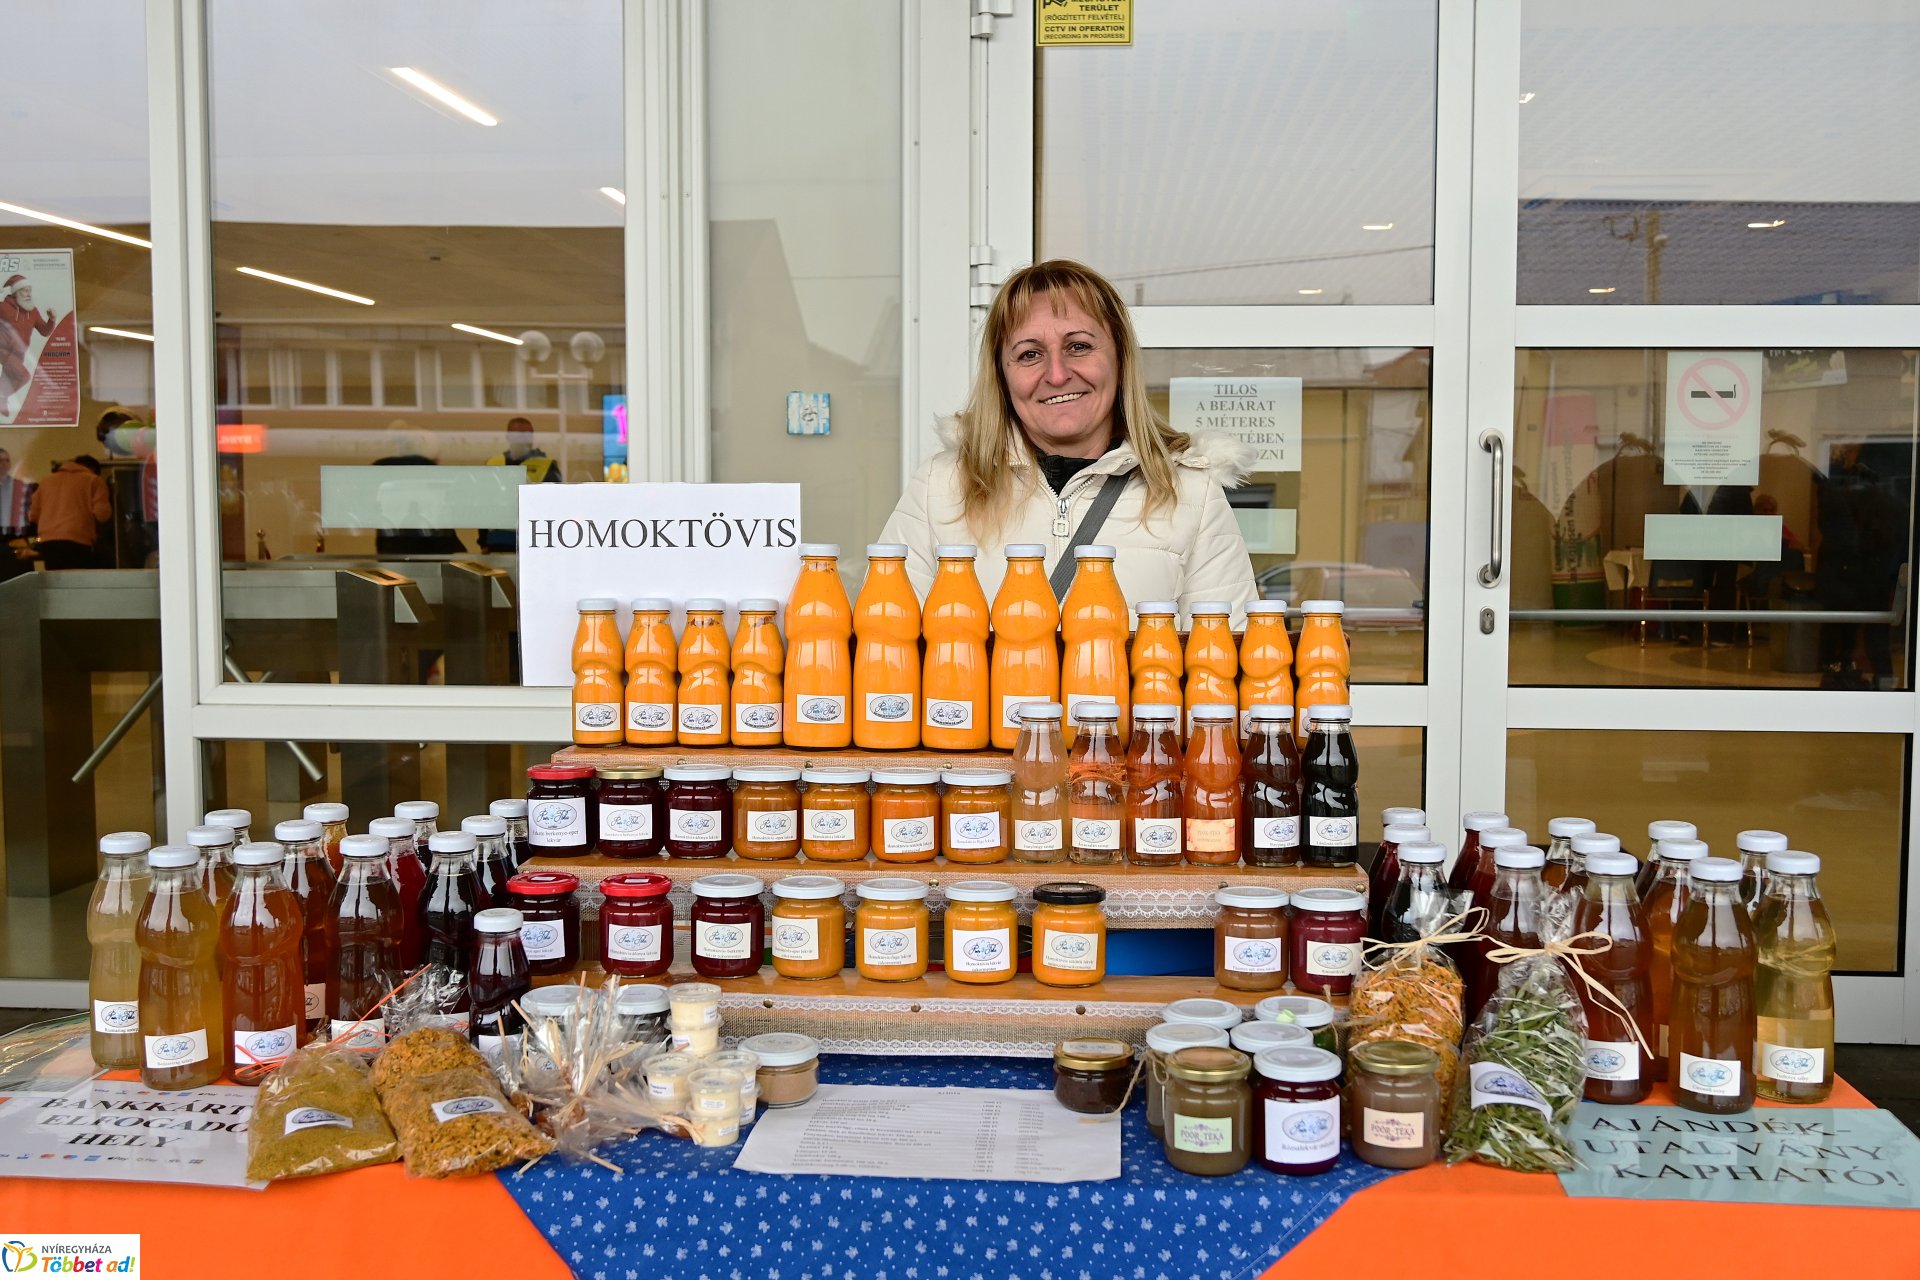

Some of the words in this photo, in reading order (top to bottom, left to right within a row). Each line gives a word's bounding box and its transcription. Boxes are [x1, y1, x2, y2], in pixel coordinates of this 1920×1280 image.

[1214, 384, 1258, 396] TILOS
[1196, 401, 1206, 412] A
[1210, 398, 1276, 412] BEJÁRAT
[1195, 417, 1203, 428] 5
[1207, 414, 1276, 428] MÉTERES
[528, 512, 798, 548] HOMOKTÖVIS
[40, 1098, 254, 1116] BANKKÁRT
[66, 1133, 181, 1148] HELY
[1582, 1138, 1885, 1160] UTALVÁNY
[1608, 1163, 1905, 1187] KAPHATÓ!
